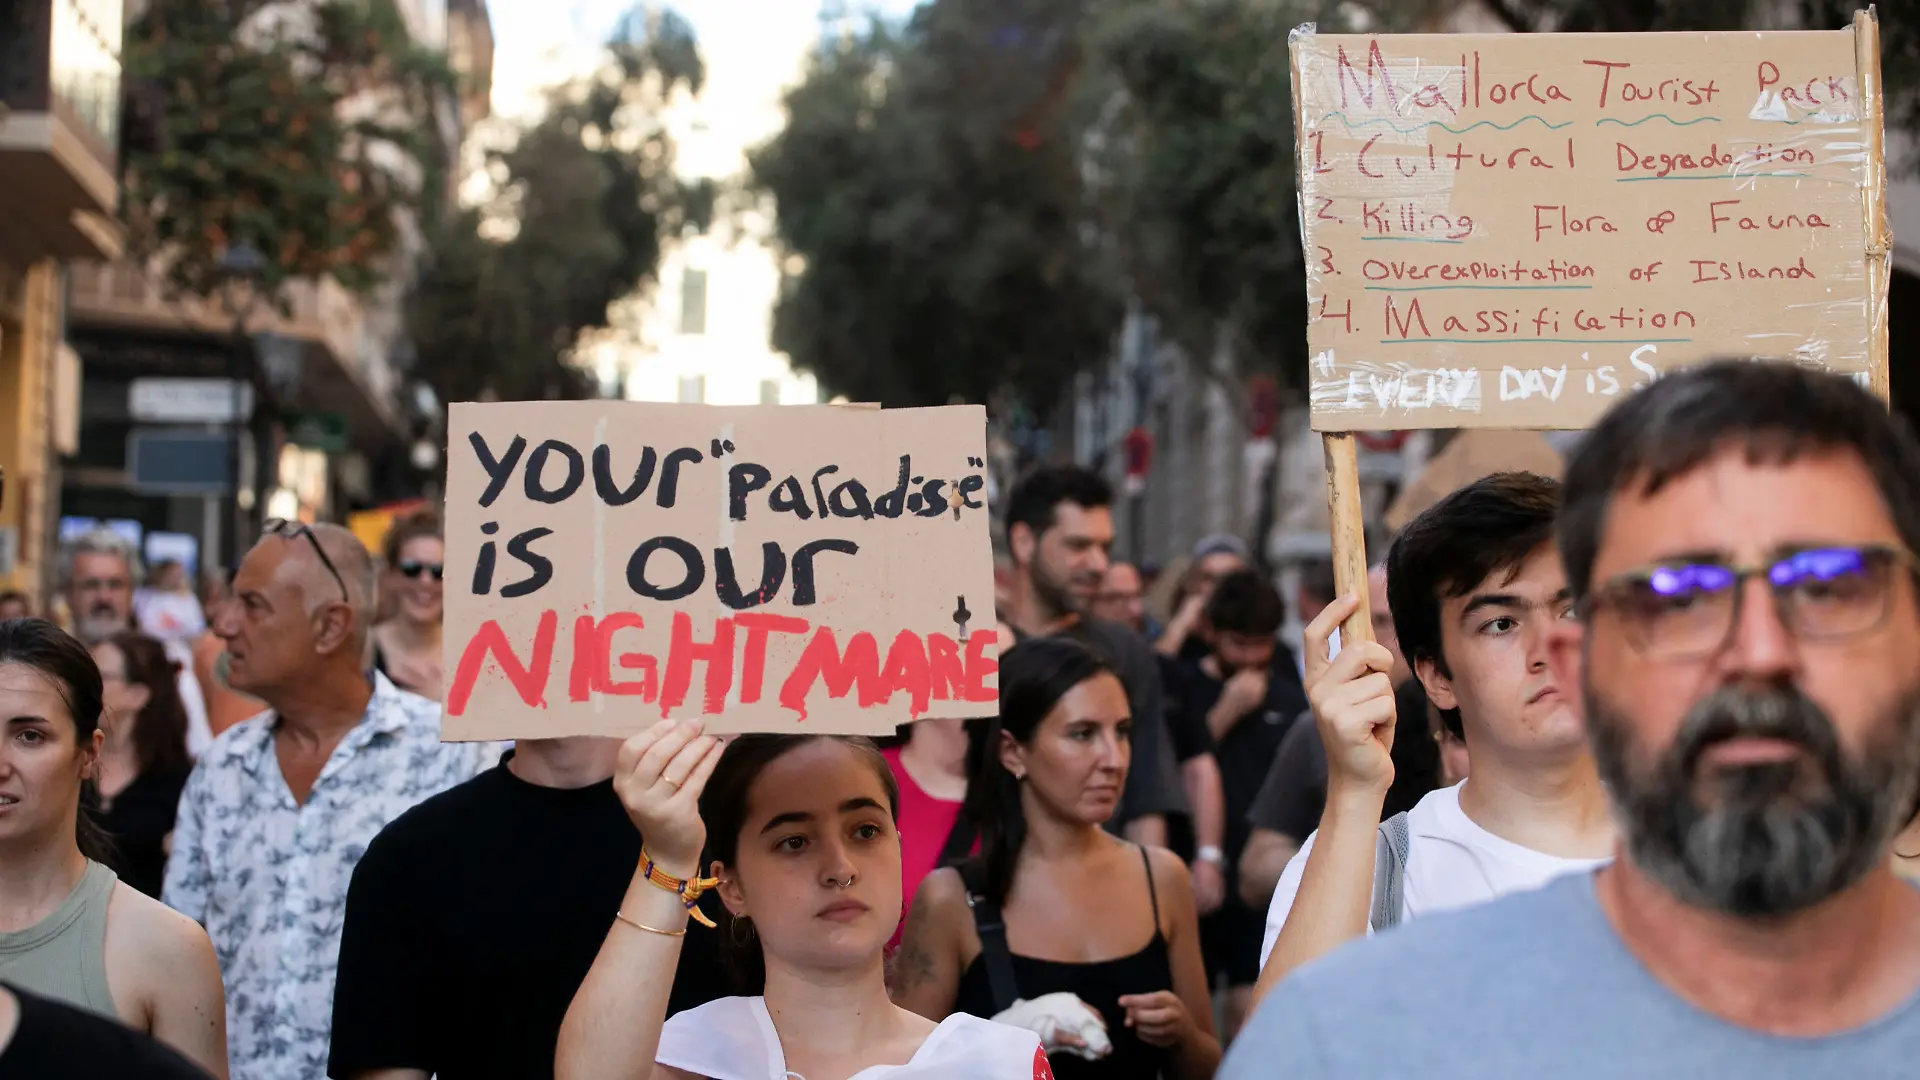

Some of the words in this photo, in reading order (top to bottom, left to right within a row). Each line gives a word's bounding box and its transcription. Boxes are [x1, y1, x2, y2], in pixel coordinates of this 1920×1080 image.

[1337, 40, 1572, 117] Mallorca
[1583, 59, 1720, 107] Tourist
[1357, 133, 1575, 179] Cultural
[1616, 143, 1815, 177] Degradation
[1315, 196, 1343, 224] 2.
[1363, 202, 1473, 239] Killing
[1533, 205, 1618, 242] Flora
[1710, 200, 1830, 234] Fauna
[1317, 246, 1342, 276] 3.
[1629, 259, 1660, 283] of
[1690, 256, 1817, 283] Island
[1319, 294, 1361, 335] 4.
[1385, 296, 1697, 340] Massification
[1500, 365, 1567, 402] DAY
[447, 609, 998, 720] NIGHTMARE
